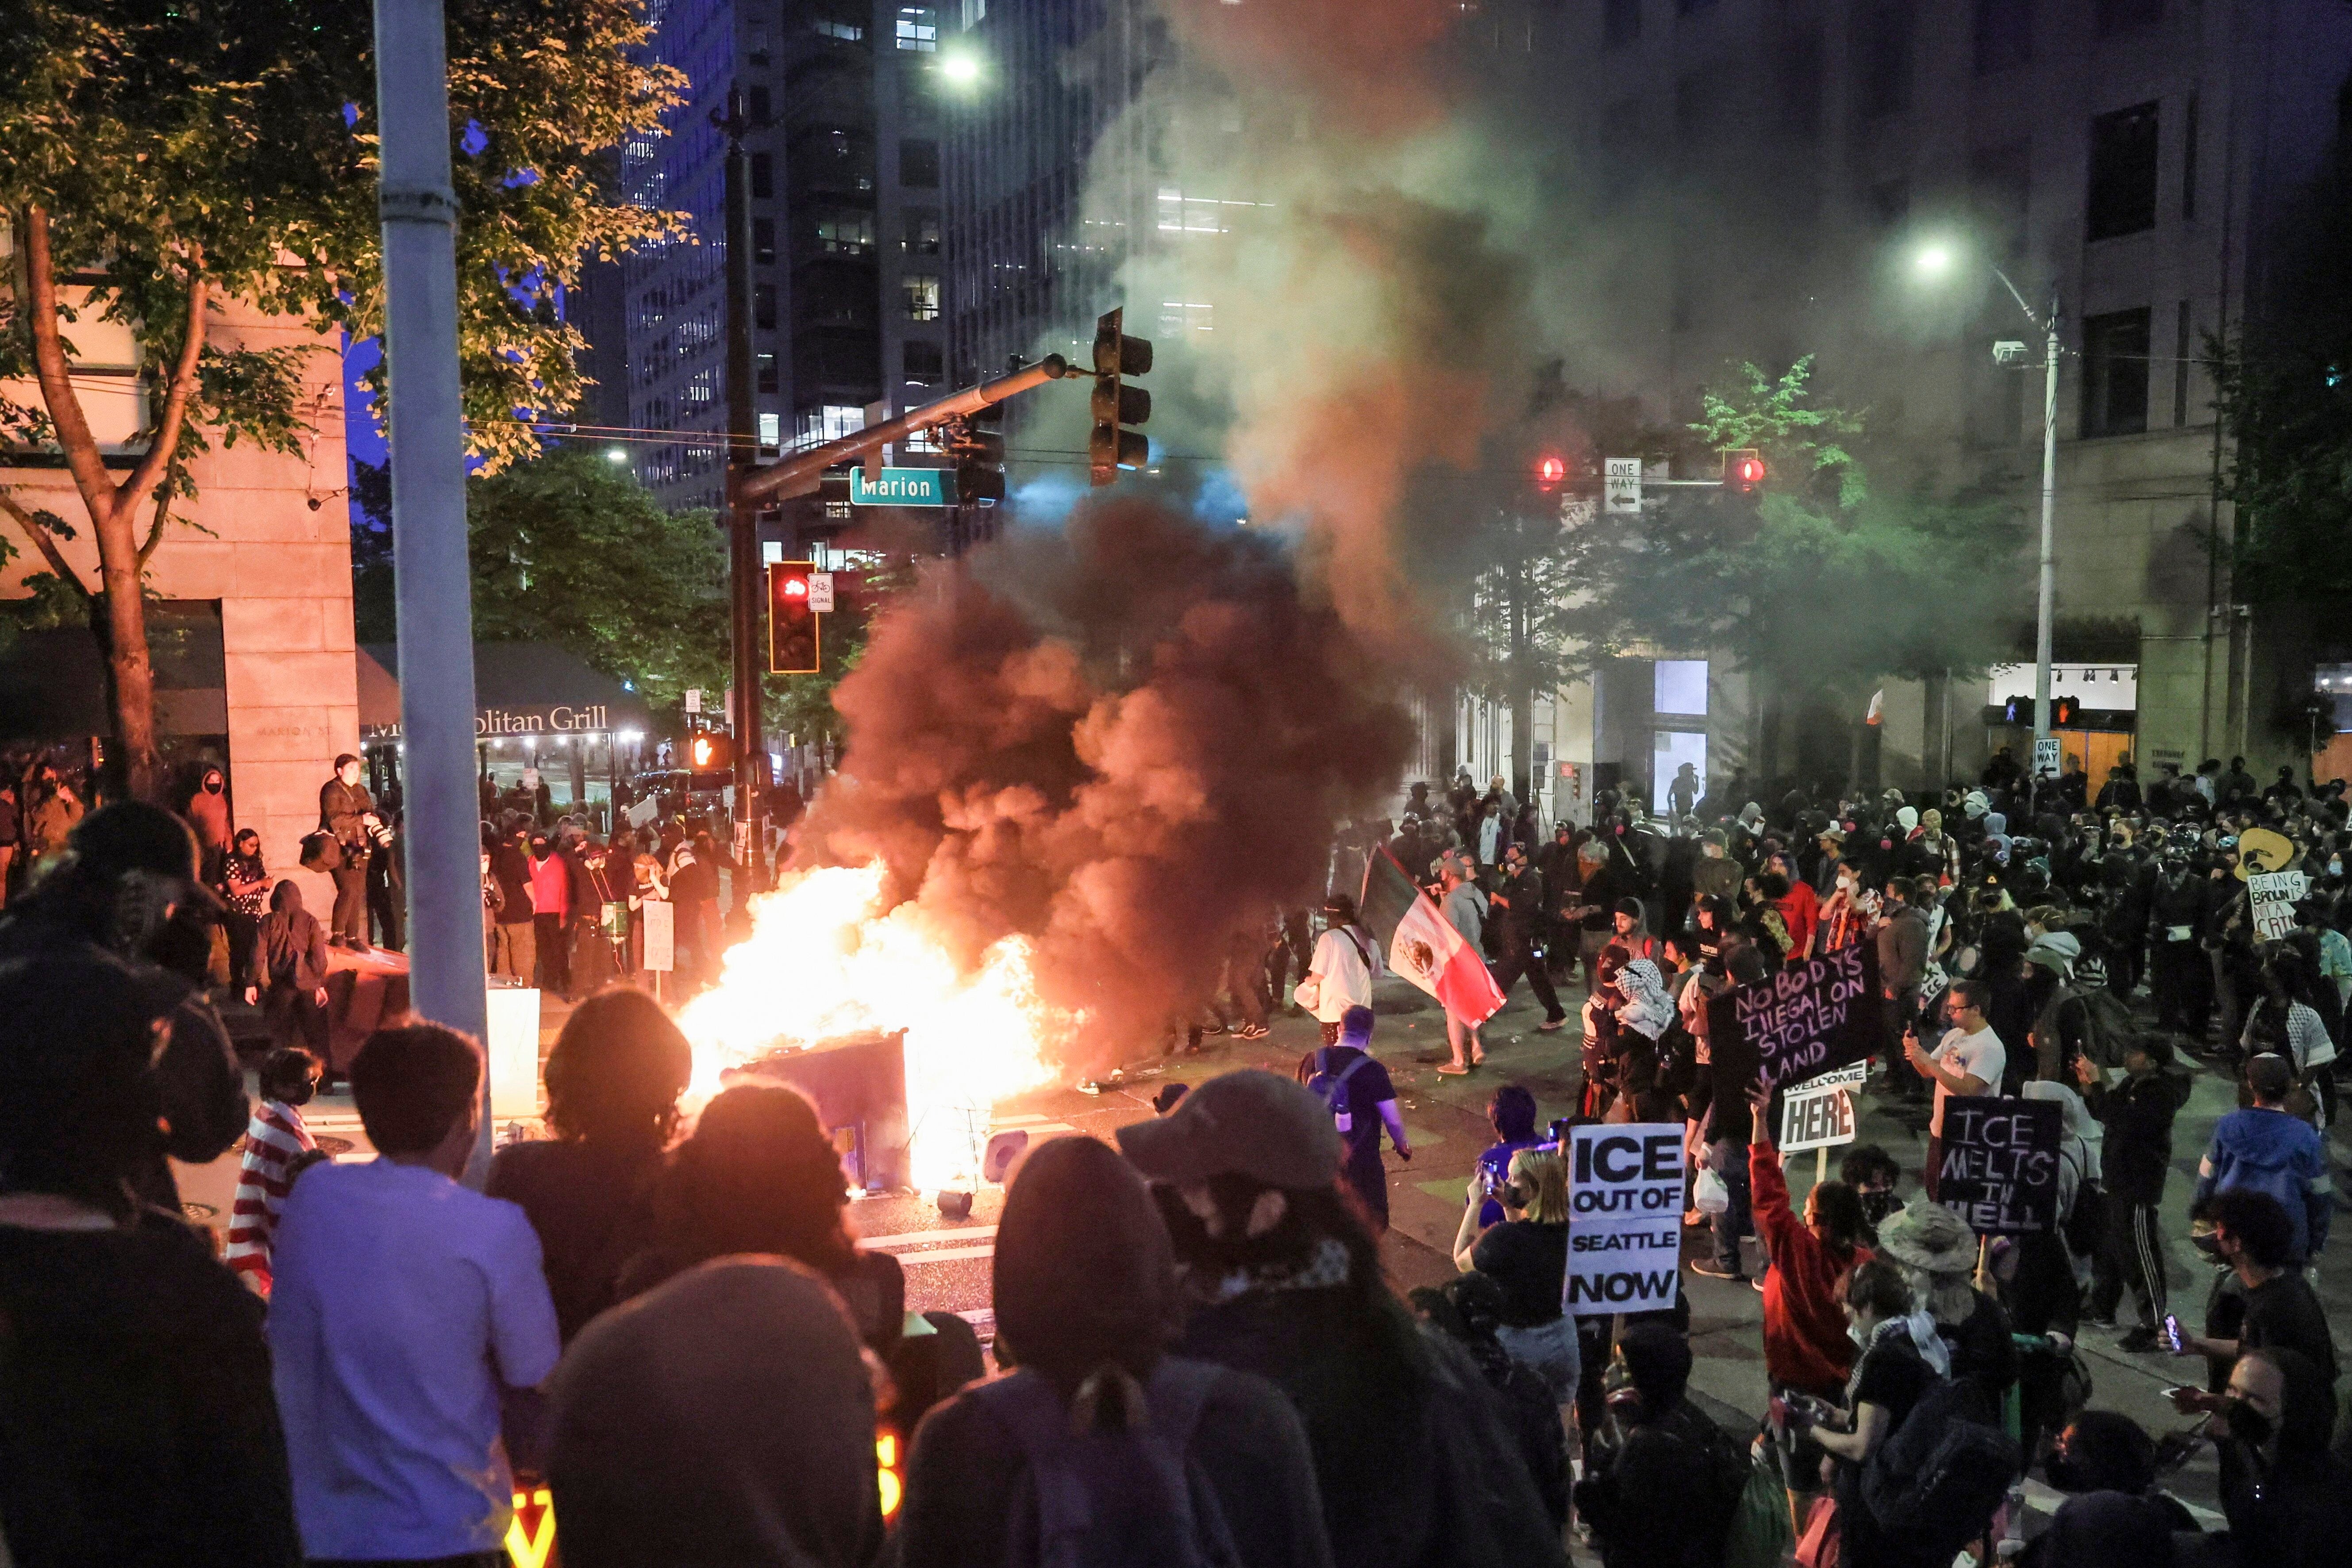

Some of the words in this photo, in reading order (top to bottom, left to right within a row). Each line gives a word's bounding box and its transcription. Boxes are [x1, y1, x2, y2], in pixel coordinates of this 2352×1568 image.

[1612, 463, 1634, 475] ONE
[861, 476, 930, 496] Marion
[1611, 478, 1634, 490] WAY
[550, 705, 608, 730] Grill
[2038, 741, 2057, 751] ONE
[2037, 753, 2058, 762] WAY
[2250, 872, 2301, 891] BEING
[2252, 889, 2290, 905] BROWN
[2275, 904, 2285, 916] A
[1741, 987, 1821, 1041] ILLEGAL
[1830, 974, 1865, 1003] ON
[1758, 1001, 1846, 1057] STOLEN
[1787, 1071, 1863, 1092] WELCOME
[1786, 1088, 1851, 1145] HERE
[1952, 1109, 2035, 1147] ICE
[1575, 1135, 1683, 1184] ICE
[1940, 1147, 2055, 1185] MELTS
[1574, 1189, 1639, 1212] OUT
[1641, 1187, 1682, 1210] OF
[1980, 1181, 2014, 1204] IN
[1572, 1231, 1677, 1252] SEATTLE
[1568, 1269, 1675, 1304] NOW
